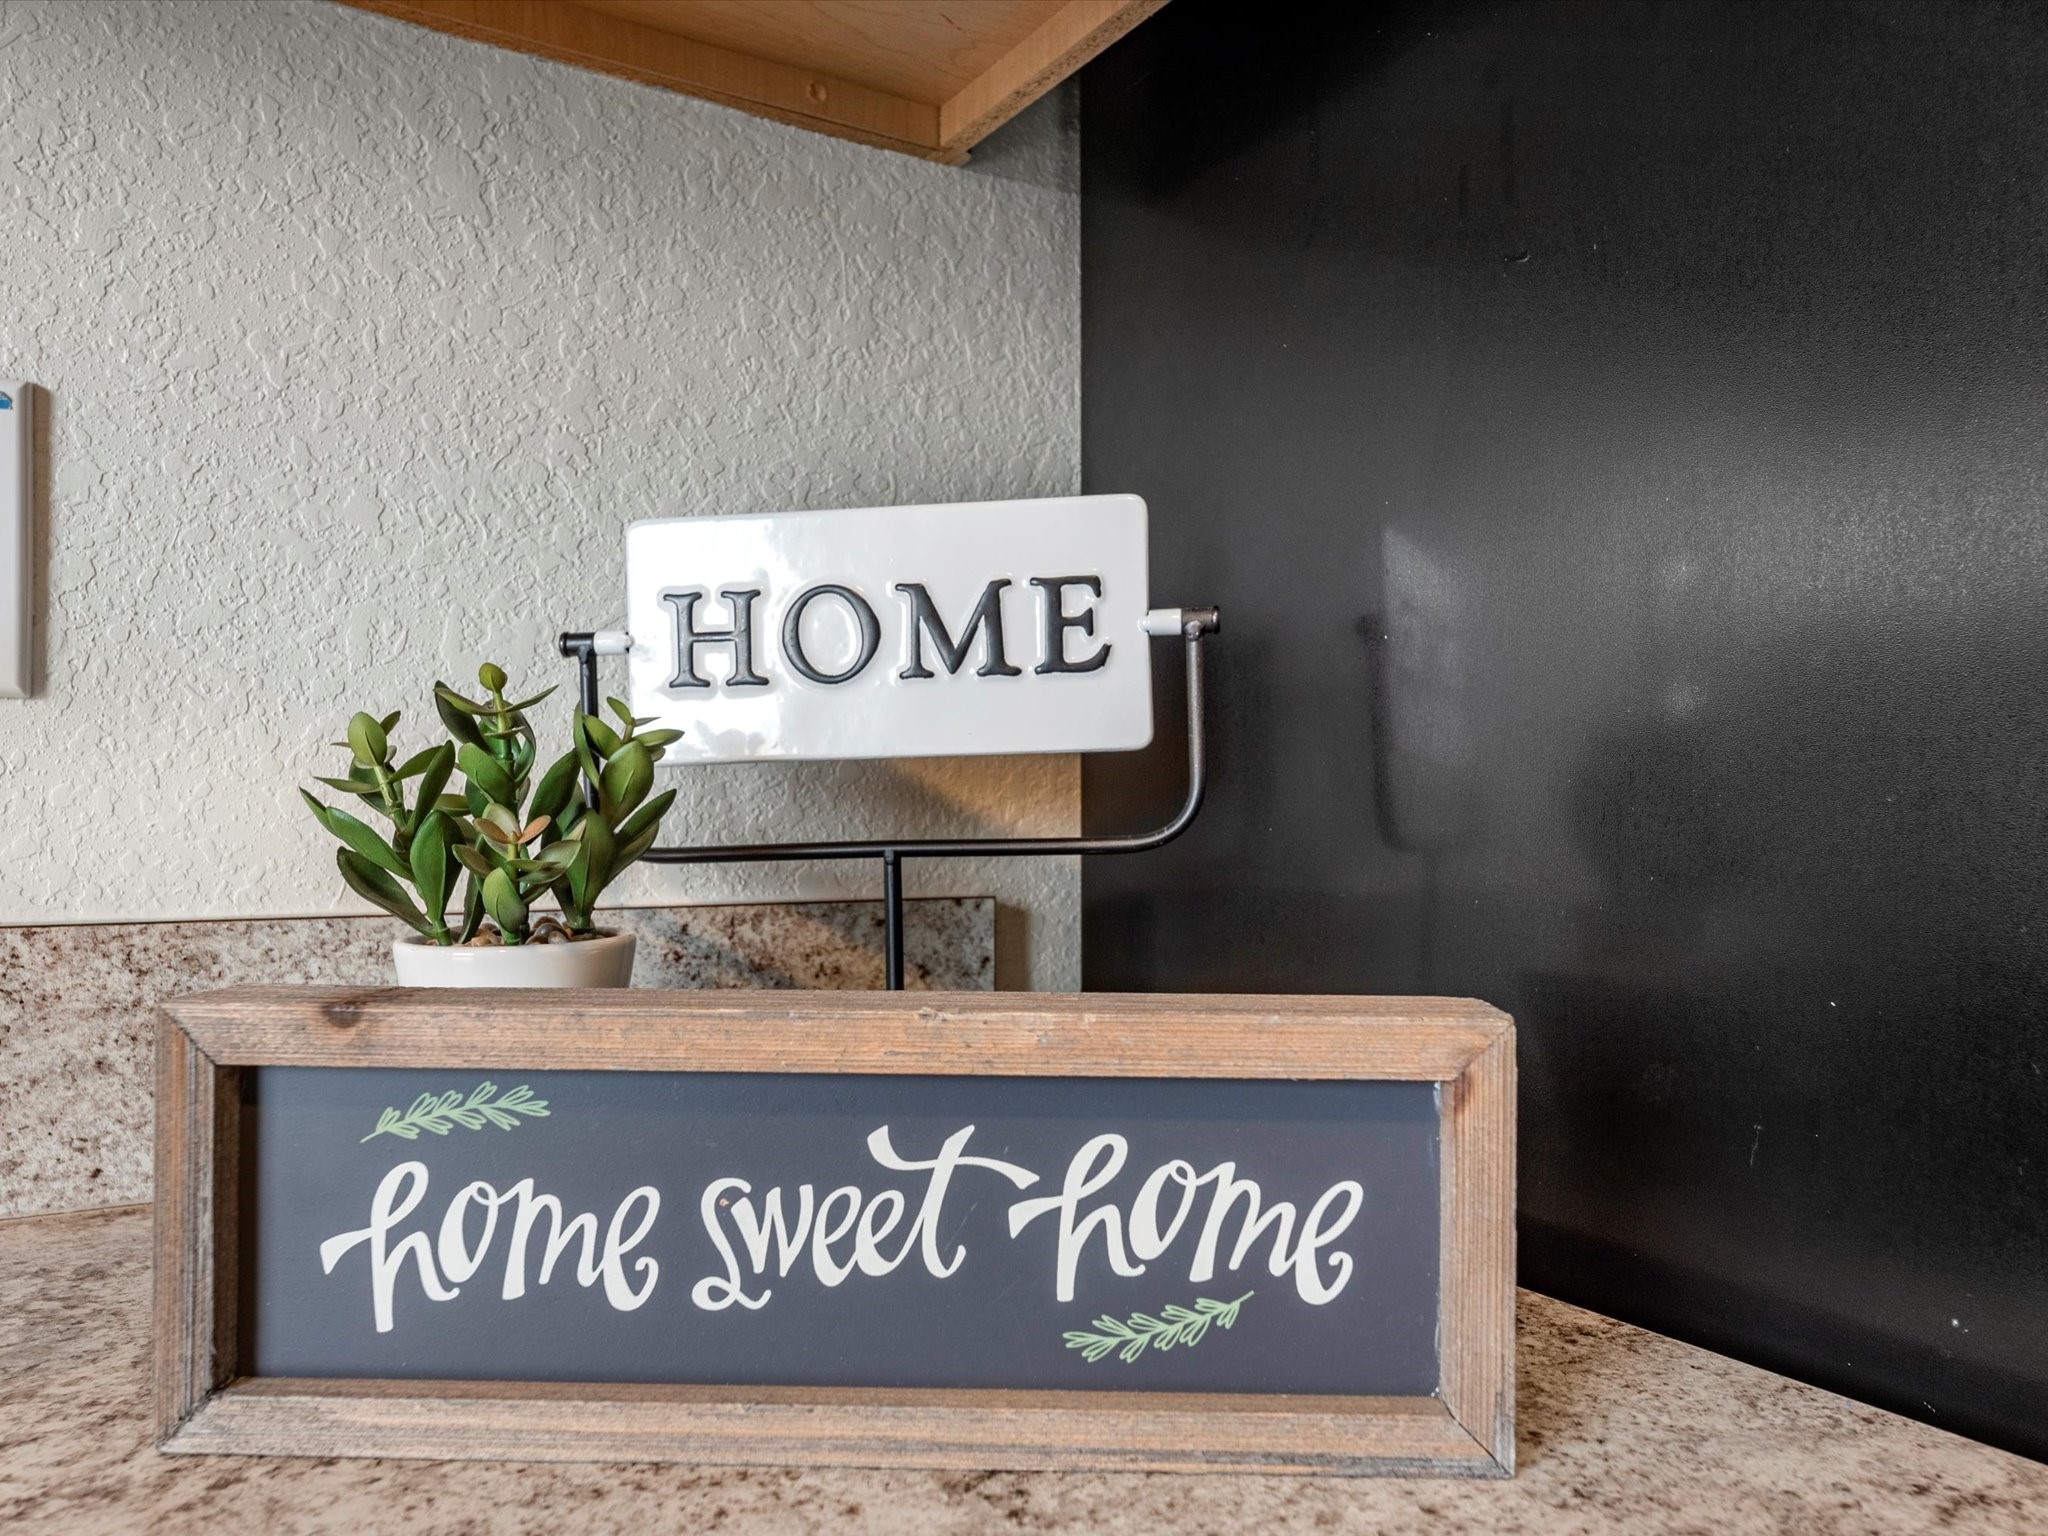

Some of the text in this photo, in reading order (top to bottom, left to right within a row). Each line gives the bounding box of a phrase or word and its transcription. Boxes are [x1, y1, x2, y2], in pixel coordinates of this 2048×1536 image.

[660, 574, 1114, 690] HOME
[319, 1124, 1364, 1334] home sweet home
